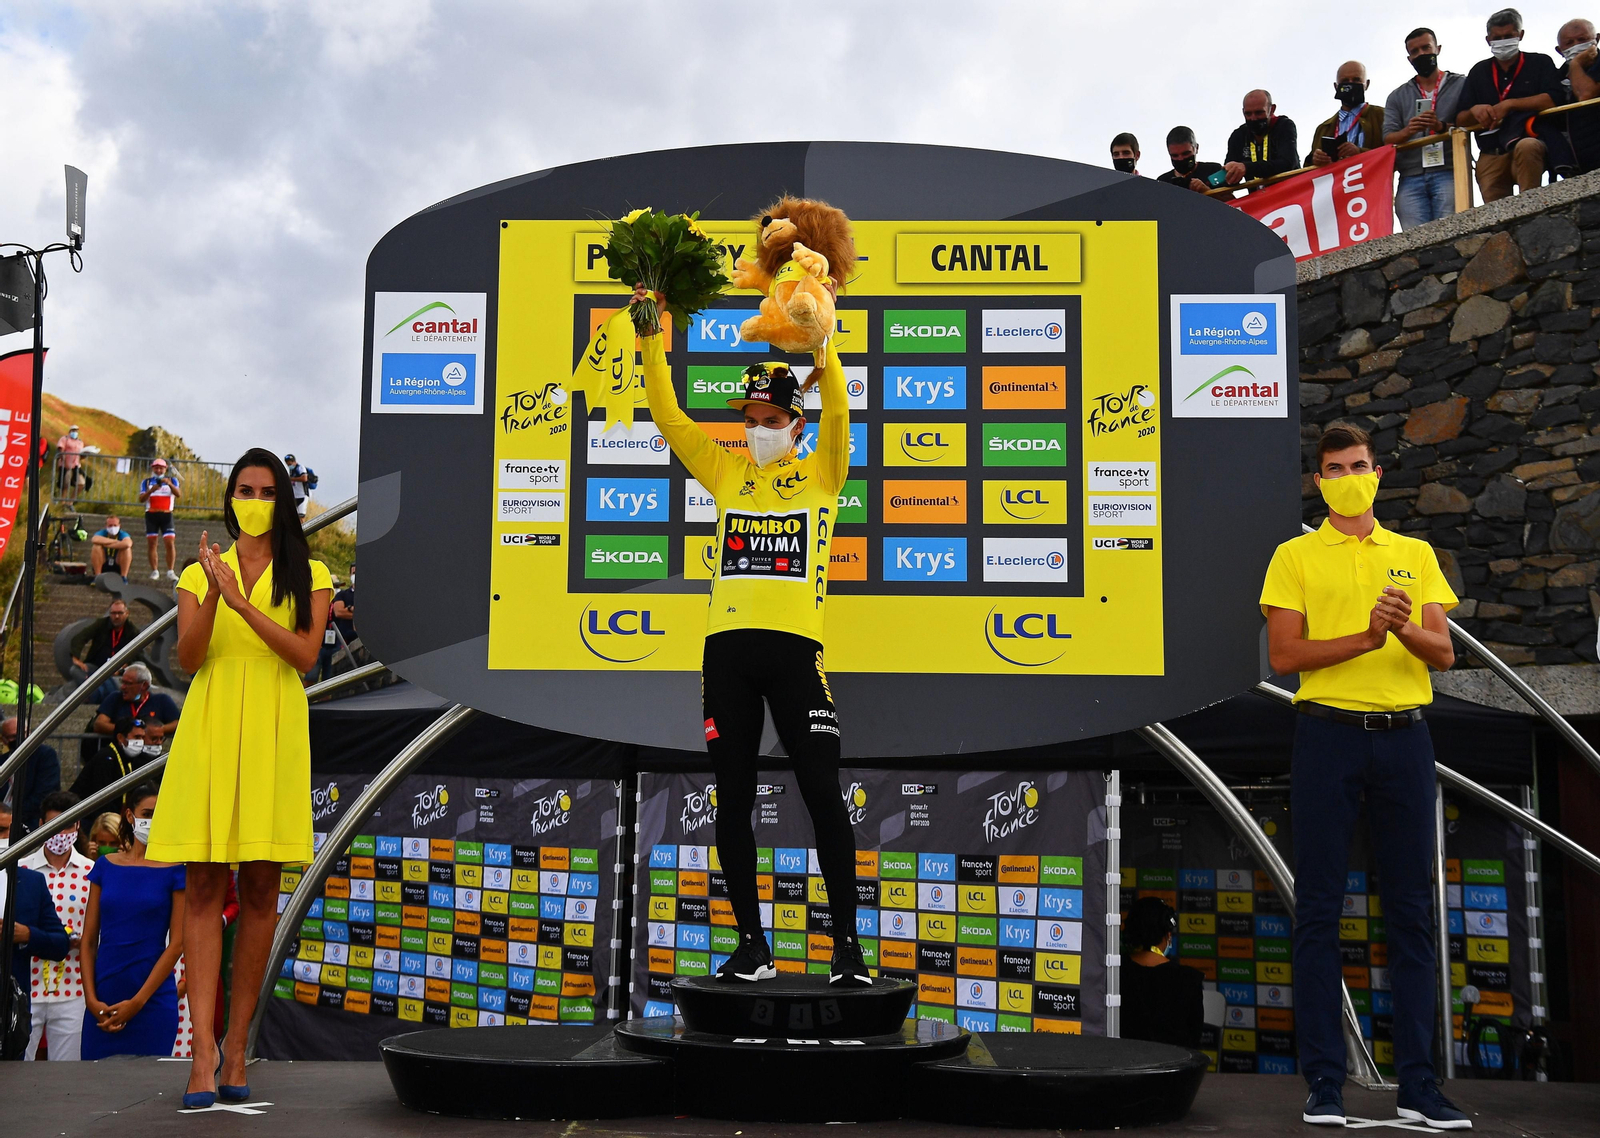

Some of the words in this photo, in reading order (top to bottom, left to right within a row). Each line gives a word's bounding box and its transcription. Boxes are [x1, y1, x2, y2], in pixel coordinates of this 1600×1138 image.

[1341, 163, 1370, 242] com
[1260, 173, 1340, 258] al
[931, 244, 1048, 271] CANTAL
[412, 318, 478, 334] cantal
[890, 323, 962, 337] ŠKODA
[985, 326, 1043, 337] E.Leclerc
[423, 334, 477, 342] DÉPARTEMENT
[701, 319, 741, 348] Kry
[1189, 328, 1201, 336] La
[1203, 327, 1240, 338] Région
[1189, 338, 1268, 346] Auvergne-Rhône-Alpes
[612, 348, 623, 391] LCL
[390, 377, 403, 387] La
[404, 376, 440, 389] Région
[693, 379, 749, 393] ŠKOD
[389, 387, 467, 397] Auvergne-Rhône-Alpes
[896, 376, 955, 404] Krys
[989, 382, 1049, 395] Continental
[1211, 382, 1278, 397] cantal
[750, 392, 770, 400] HEMA
[542, 402, 552, 410] de
[1223, 398, 1278, 406] DÉPARTEMENT
[1129, 404, 1139, 412] de
[549, 424, 567, 435] 2020
[1137, 426, 1156, 438] 2020
[591, 438, 648, 449] E.Leclerc
[714, 438, 748, 448] inenta
[905, 433, 949, 447] LCL
[988, 437, 1062, 451] ŠKODA
[529, 474, 559, 485] sport
[776, 471, 808, 488] LCL
[1119, 477, 1149, 489] sport
[599, 488, 658, 516] Krys
[890, 495, 950, 508] Continental
[1005, 490, 1049, 504] LCL
[728, 518, 801, 535] JUMBO
[817, 507, 829, 553] LCL
[503, 535, 523, 544] UCI
[750, 536, 800, 553] VISMA
[1095, 539, 1115, 548] UCI
[591, 549, 663, 564] ŠKODA
[896, 547, 955, 576] Krys
[986, 555, 1045, 566] E.Leclerc
[1390, 569, 1416, 579] LCL
[815, 565, 824, 610] LCL
[588, 610, 665, 635] LCL
[993, 613, 1072, 638] LCL
[810, 723, 840, 735] Bianch
[903, 785, 917, 793] UCI
[1018, 804, 1026, 813] de
[380, 840, 397, 854] Krys
[488, 848, 507, 863] Krys
[573, 855, 593, 864] ŠKODA
[653, 849, 671, 863] Krys
[780, 853, 800, 868] Krys
[883, 860, 912, 869] ŠKODA
[924, 859, 948, 876] Krys
[1001, 864, 1031, 873] Continental
[975, 868, 992, 877] sport
[1043, 866, 1077, 876] ŠKODA
[1185, 873, 1209, 884] Krys
[571, 878, 592, 892] Krys
[890, 887, 907, 896] LCL
[968, 891, 986, 901] LCL
[1471, 890, 1498, 905] Krys
[511, 901, 535, 909] ŠKODA
[654, 902, 669, 910] LCL
[1044, 894, 1072, 913] Krys
[856, 917, 871, 930] rys
[928, 919, 946, 929] LCL
[1261, 920, 1284, 932] Krys
[573, 928, 587, 936] LCL
[961, 926, 992, 936] ŠKODA
[1005, 925, 1030, 940] Krys
[683, 930, 705, 946] Krys
[777, 941, 802, 950] ŠKODA
[1478, 943, 1498, 953] LCL
[680, 958, 707, 969] ŠKODA
[935, 958, 950, 967] sport
[960, 956, 988, 966] Continental
[1046, 960, 1068, 971] LCL
[1016, 964, 1030, 973] sport
[1009, 990, 1024, 1000] LCL
[1053, 1001, 1076, 1011] sport
